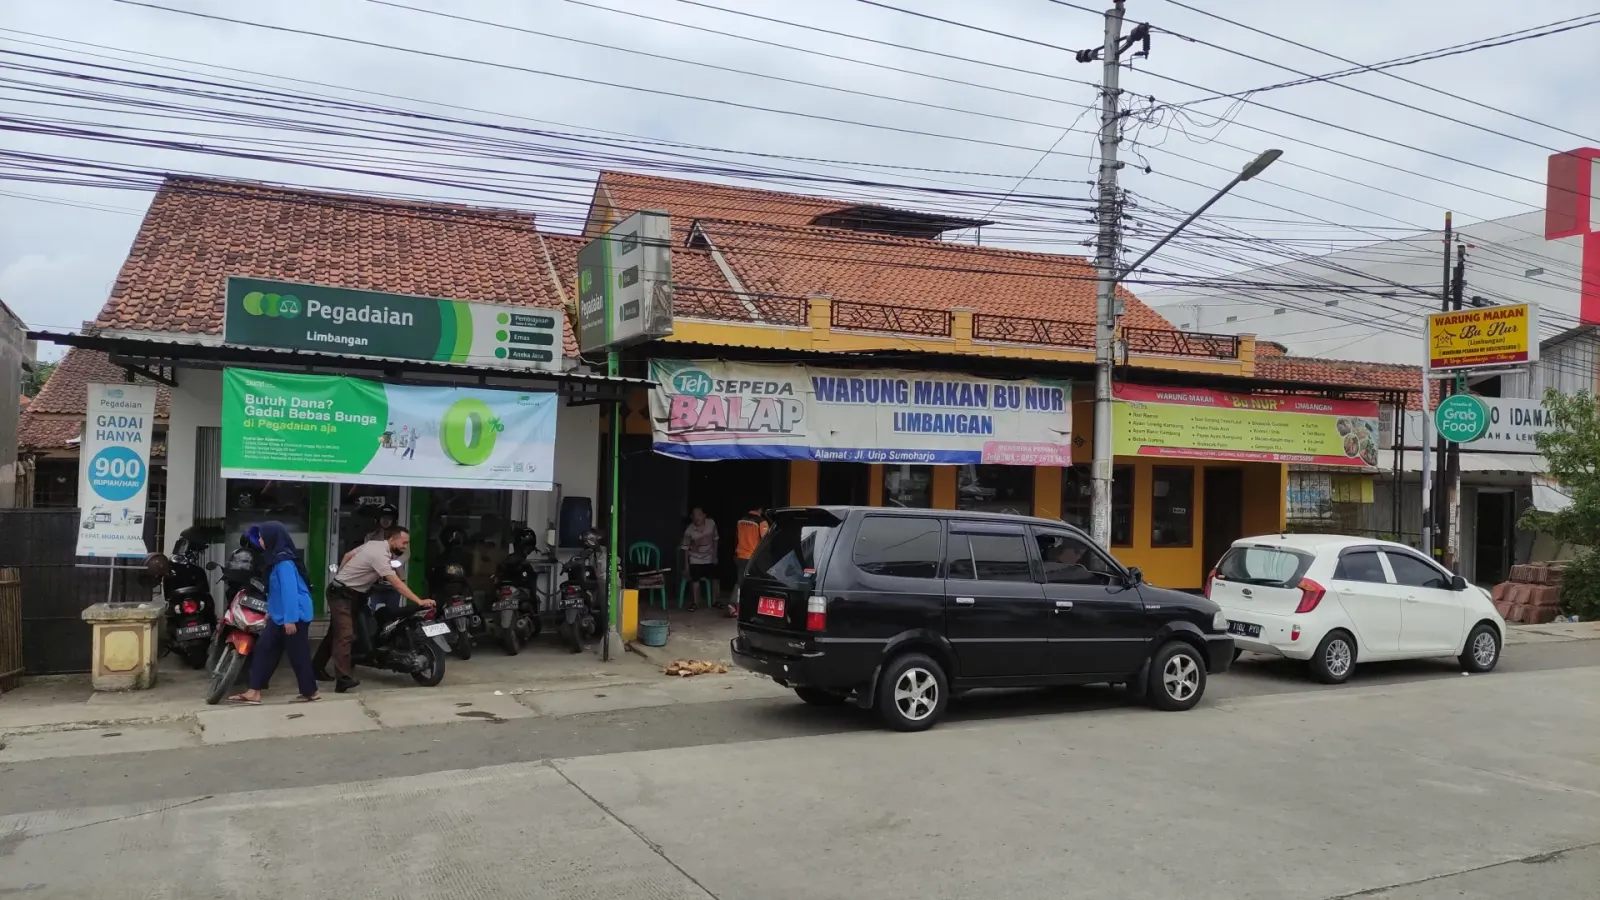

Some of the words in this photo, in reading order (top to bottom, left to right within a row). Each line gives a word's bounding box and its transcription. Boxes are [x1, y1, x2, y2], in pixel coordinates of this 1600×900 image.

[307, 300, 414, 327] Pegadaian
[1435, 313, 1480, 326] WARUNG
[1483, 308, 1524, 321] MAKAN
[1459, 324, 1481, 339] Bu
[1486, 321, 1519, 337] Nur
[307, 331, 368, 347] Limbangan
[679, 374, 709, 393] Teh
[714, 379, 794, 396] SEPEDA
[812, 376, 909, 404] WARUNG
[914, 380, 989, 408] MAKAN
[993, 384, 1021, 409] BU
[1025, 386, 1064, 411] NUR
[1156, 392, 1188, 401] WARUNG
[1189, 394, 1214, 403] MAKAN
[100, 399, 142, 409] Pegadaian
[245, 394, 286, 407] Butuh
[291, 397, 333, 409] Dana?
[1251, 398, 1278, 410] NUR
[1295, 402, 1333, 411] LIMBANGAN
[245, 406, 284, 418] Gadai
[289, 408, 331, 421] Bebas
[335, 411, 377, 426] Bunga
[667, 394, 804, 432] BALAP
[1444, 408, 1477, 420] Grab
[97, 414, 143, 429] GADAI
[243, 419, 254, 428] di
[258, 420, 317, 432] Pegadaian
[320, 424, 337, 434] aja
[893, 411, 993, 435] LIMBANGAN
[1442, 420, 1477, 432] Food
[96, 429, 142, 443] HANYA
[814, 449, 847, 460] Alamat
[868, 450, 887, 462] Urip
[889, 451, 935, 463] Sumoharjo
[95, 457, 140, 478] 900
[93, 479, 139, 488] RUPIAH/HARI
